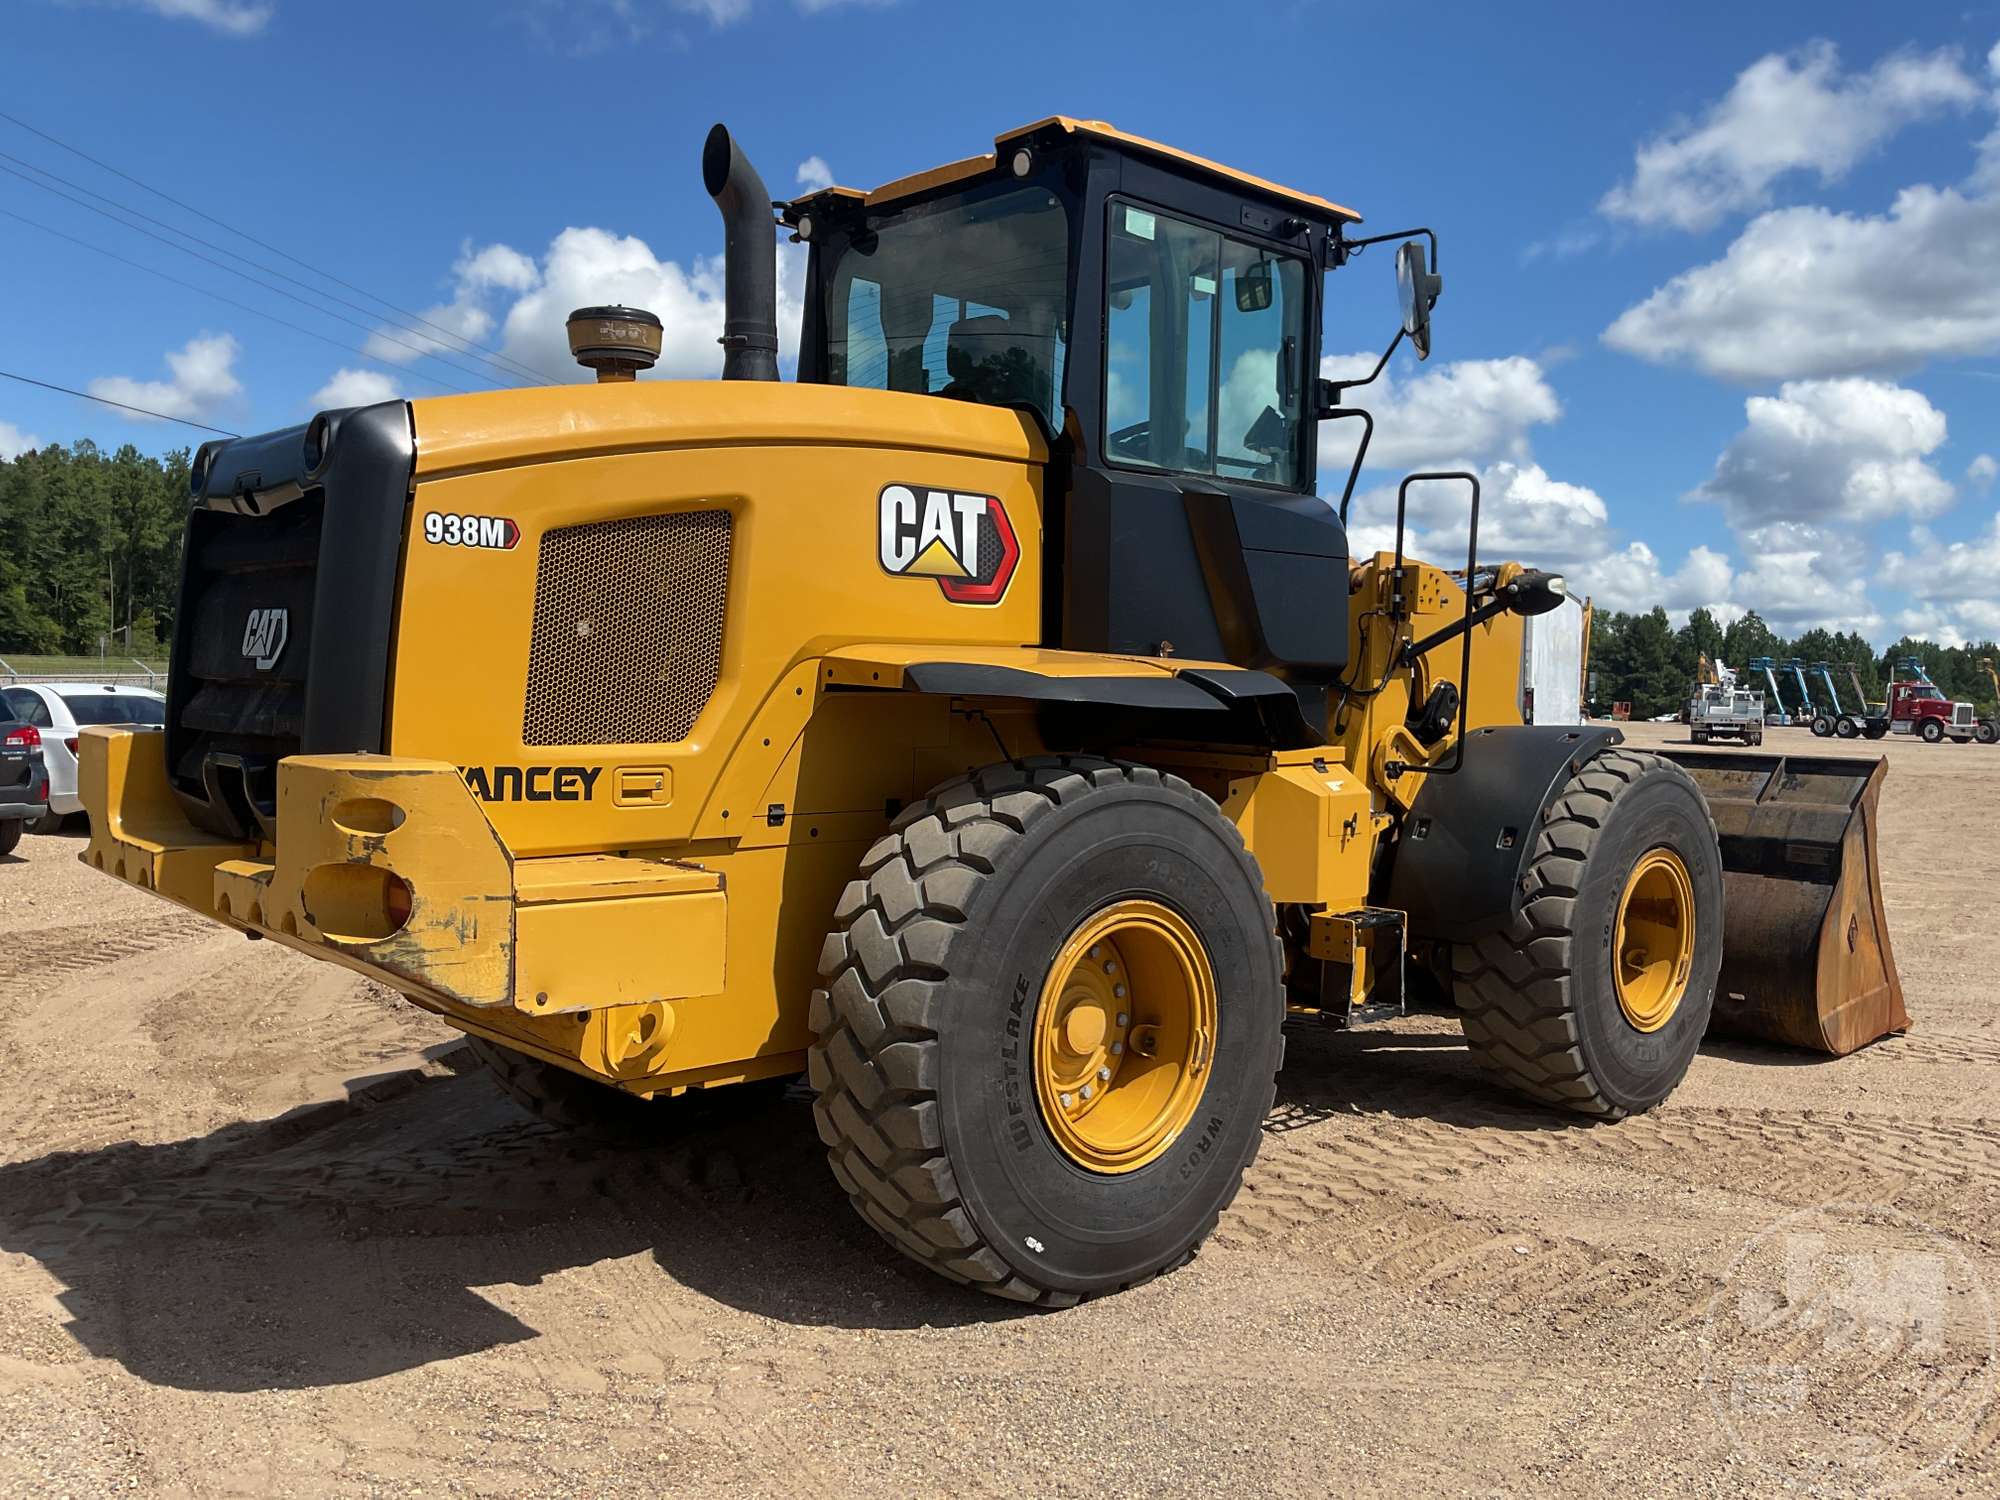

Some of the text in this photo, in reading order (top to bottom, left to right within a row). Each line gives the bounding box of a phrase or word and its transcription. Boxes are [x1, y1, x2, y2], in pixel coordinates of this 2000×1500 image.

[425, 512, 505, 548] 938M
[880, 485, 987, 578] CAT
[242, 608, 283, 657] CAT
[456, 766, 603, 802] ANCEY
[1002, 973, 1034, 1153] WESTLAKE
[1180, 1117, 1224, 1180] WR03
